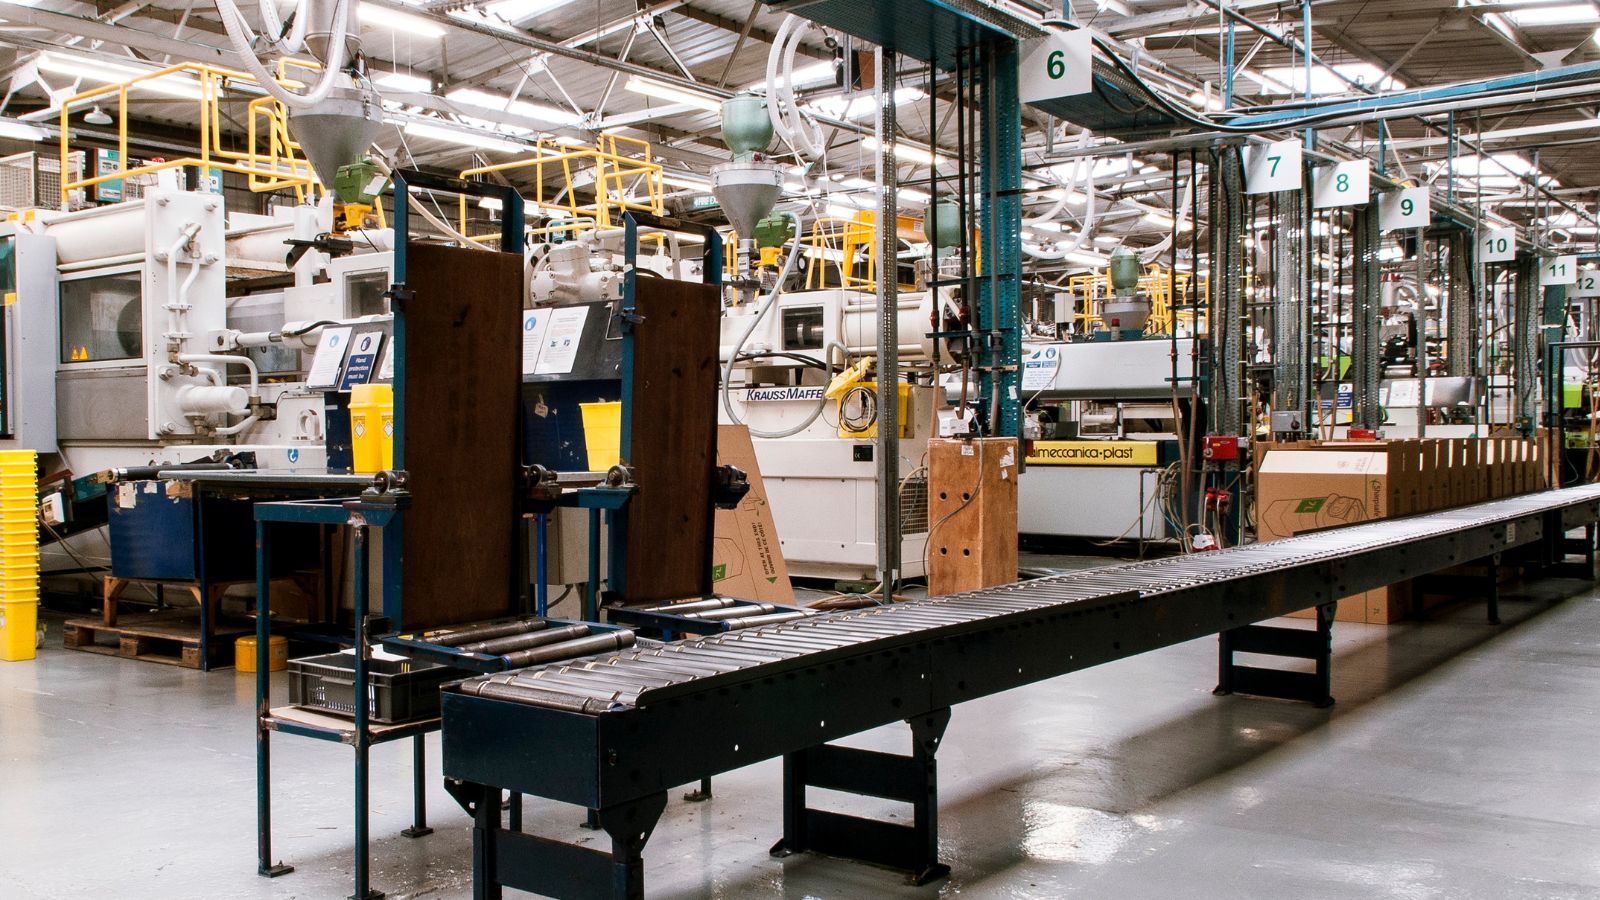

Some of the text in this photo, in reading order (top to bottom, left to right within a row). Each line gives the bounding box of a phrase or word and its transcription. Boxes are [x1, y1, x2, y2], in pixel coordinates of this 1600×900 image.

[1046, 49, 1066, 79] 6
[1267, 155, 1281, 177] 7
[1335, 172, 1350, 193] 8
[1400, 197, 1414, 217] 9
[1486, 238, 1508, 253] 10
[1549, 263, 1566, 277] 11
[1576, 277, 1595, 290] 12
[746, 388, 824, 401] KRAUSSMAFFE
